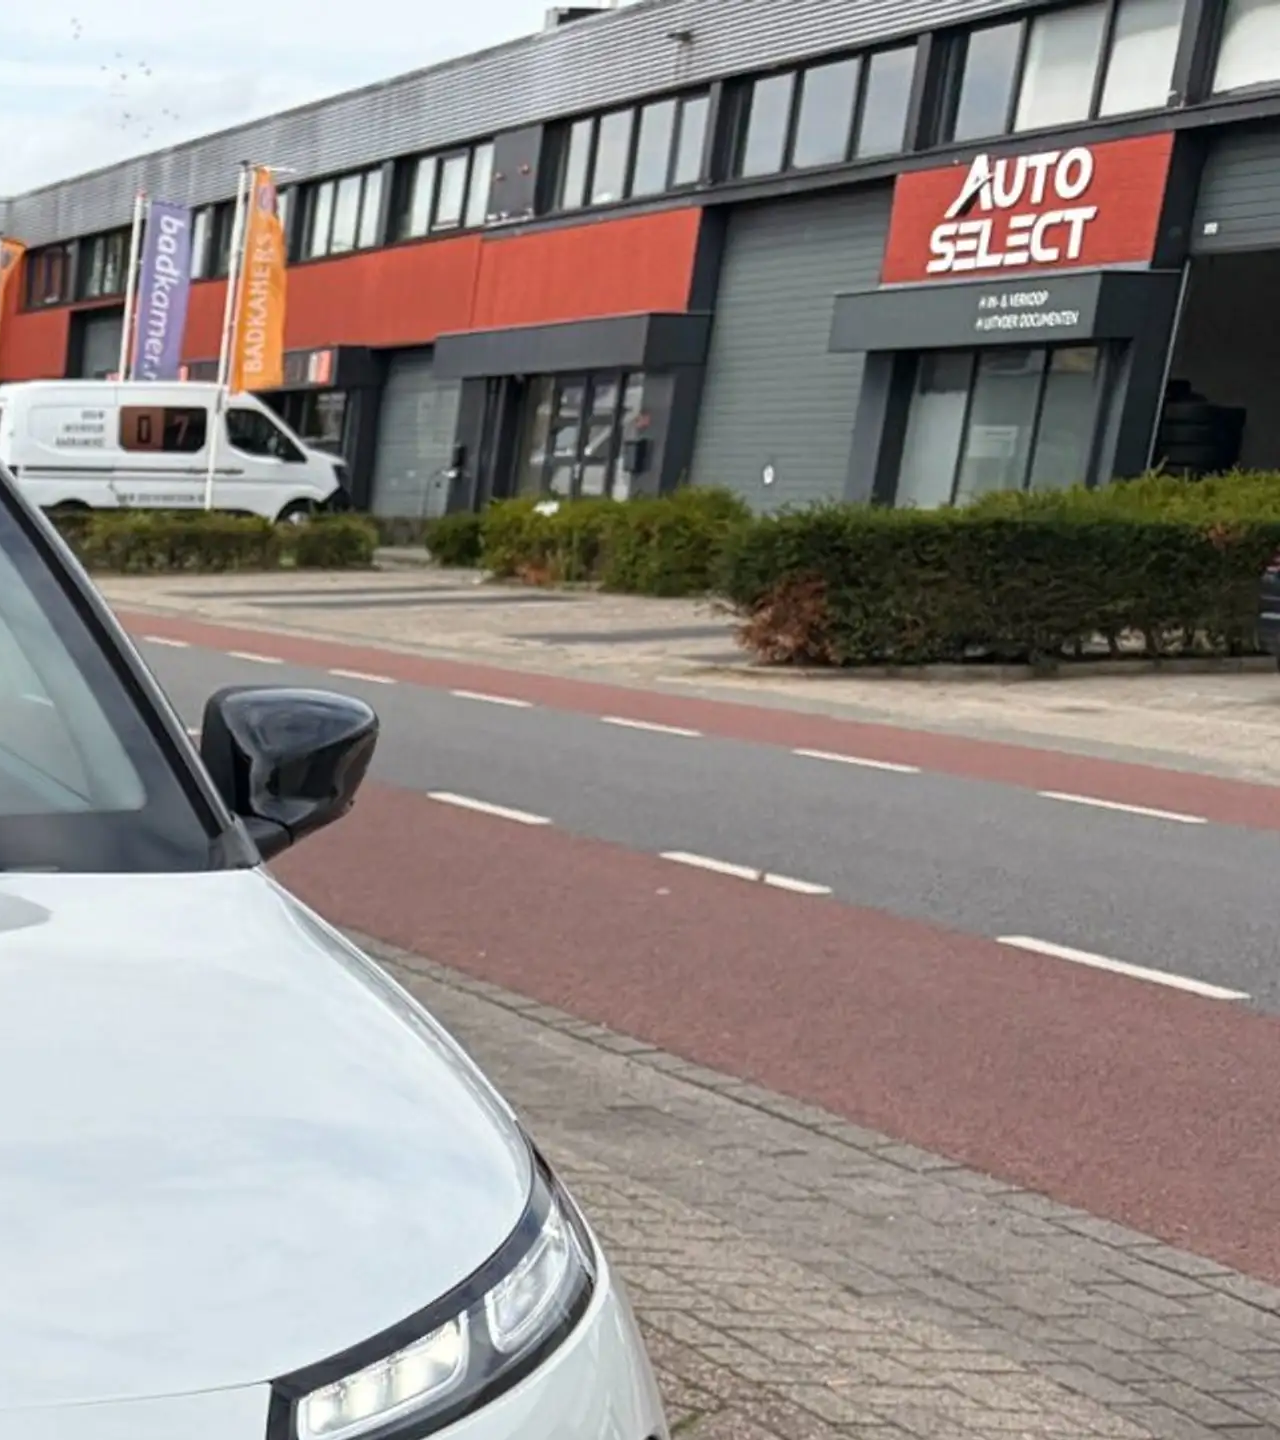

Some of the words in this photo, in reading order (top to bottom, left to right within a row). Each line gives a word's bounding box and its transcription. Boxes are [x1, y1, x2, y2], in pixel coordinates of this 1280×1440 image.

[944, 147, 1093, 219] AUTO
[926, 206, 1097, 273] SELECT
[243, 232, 275, 374] BADKAMERS
